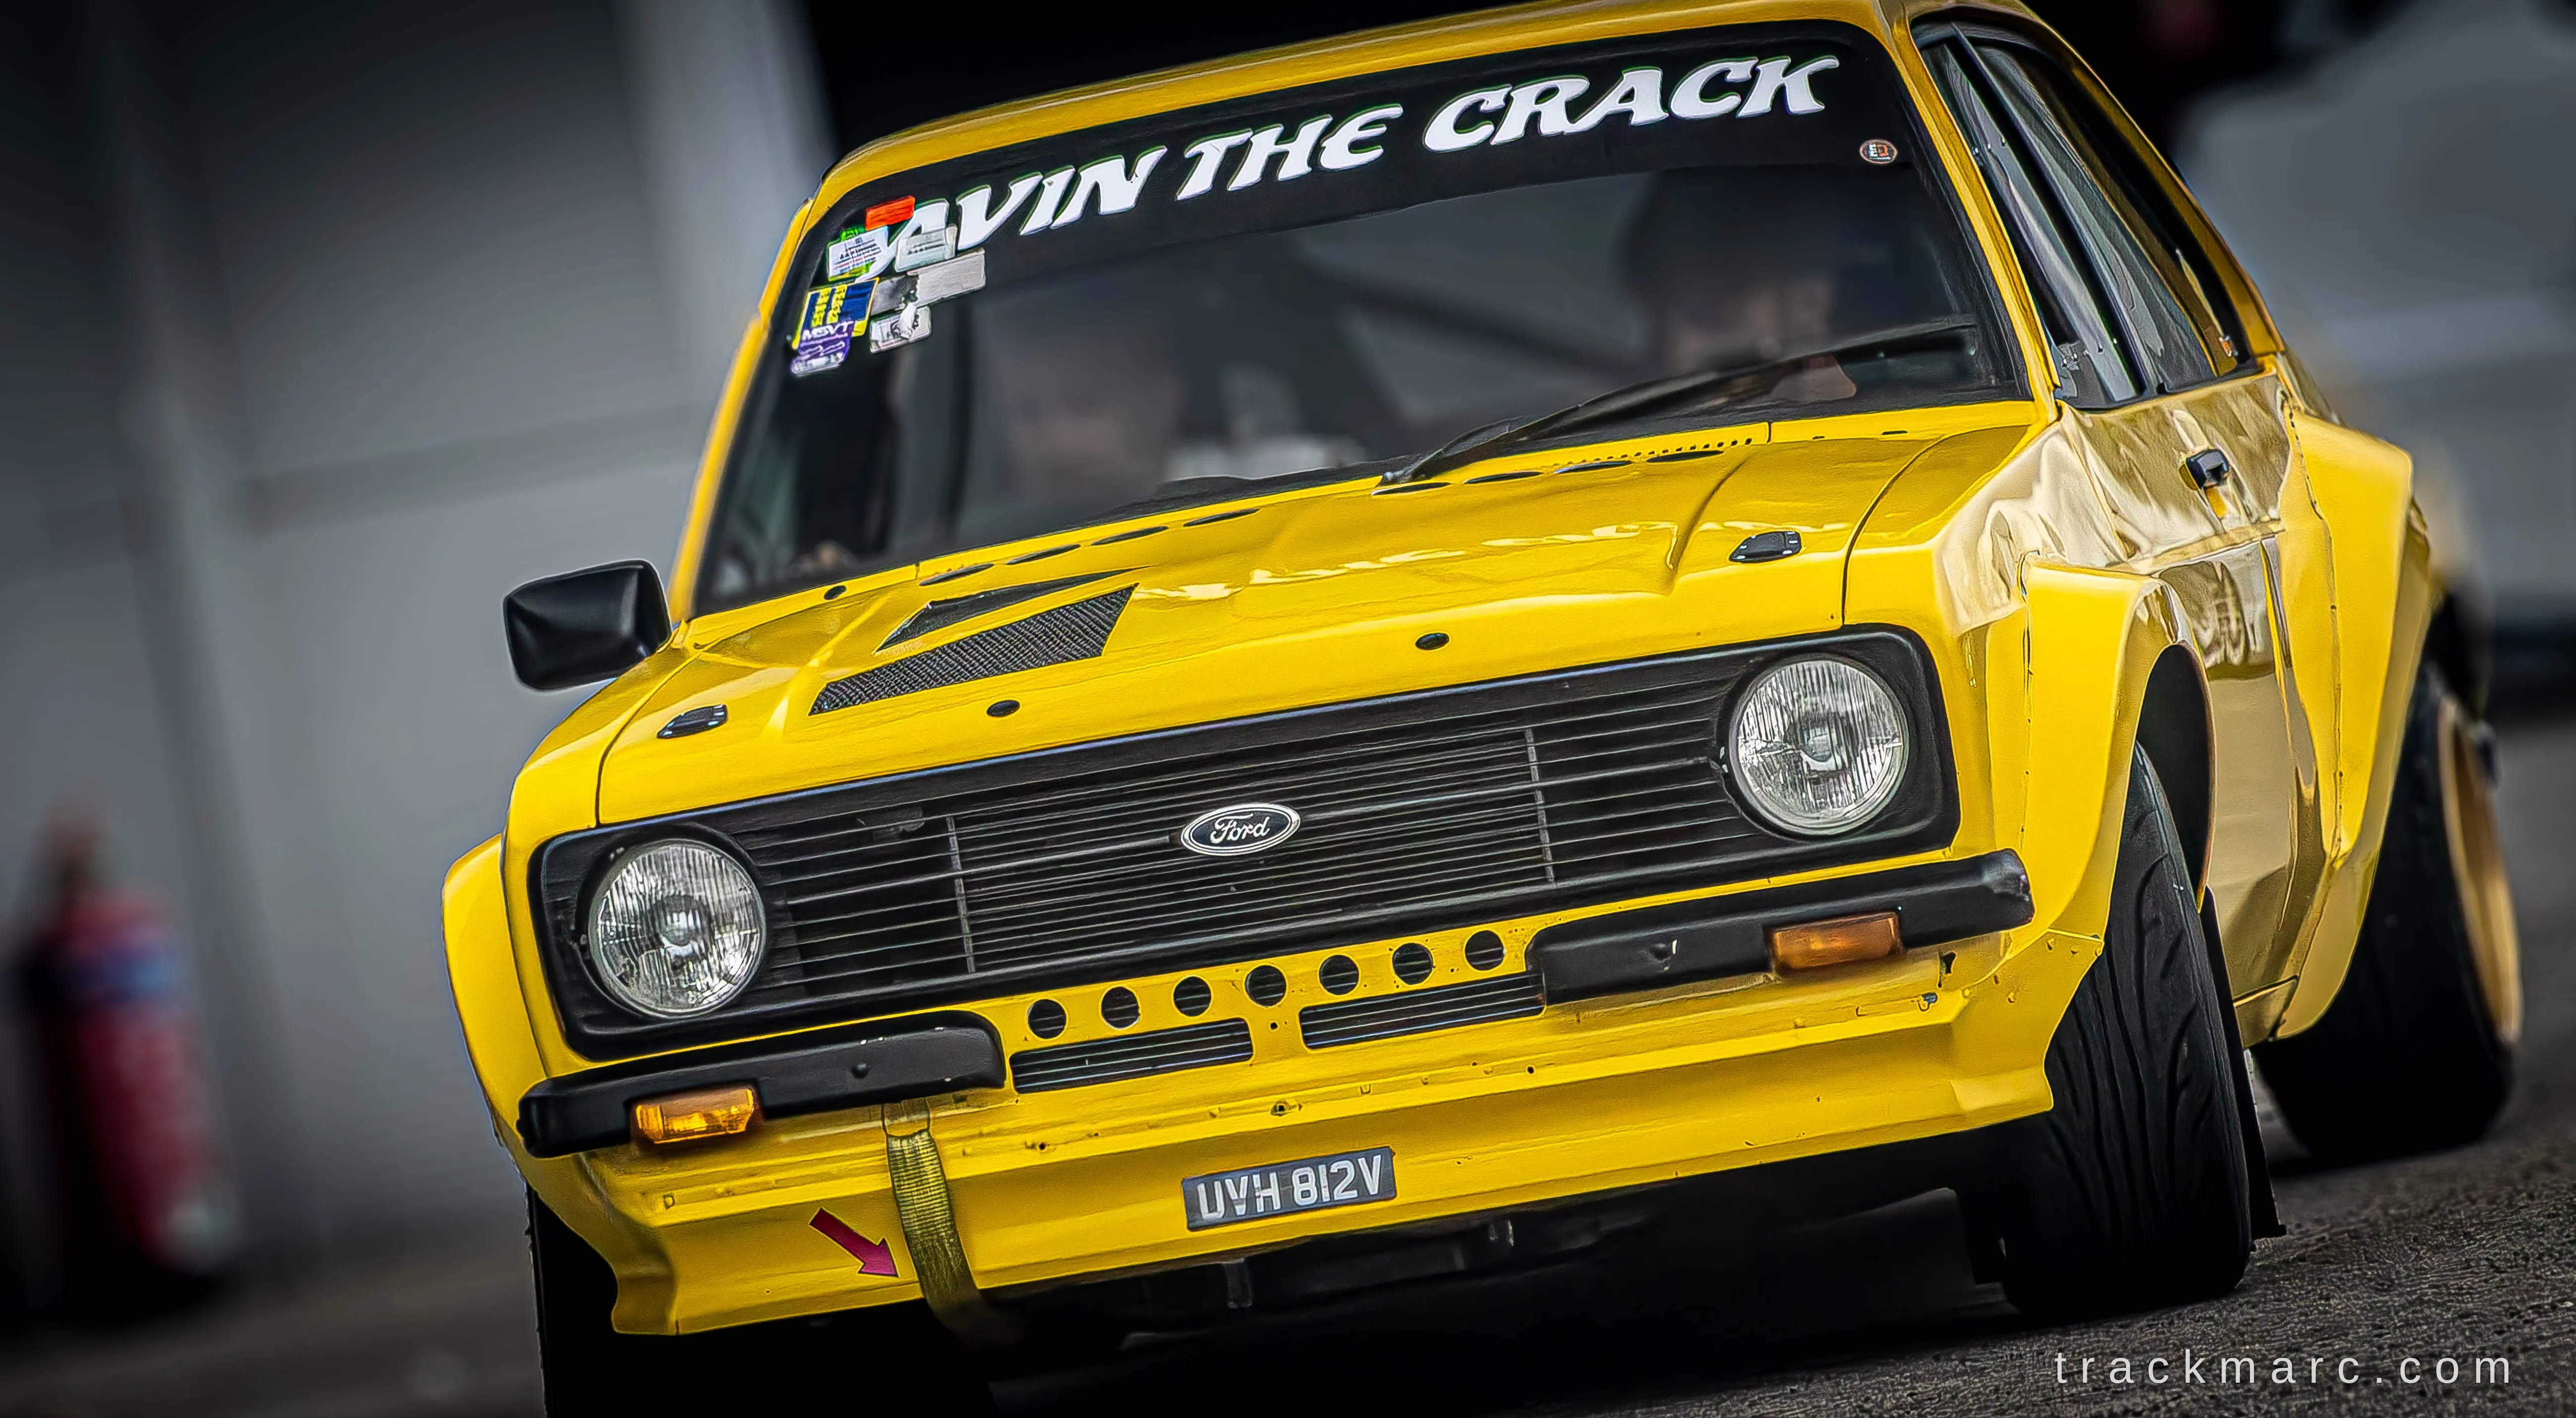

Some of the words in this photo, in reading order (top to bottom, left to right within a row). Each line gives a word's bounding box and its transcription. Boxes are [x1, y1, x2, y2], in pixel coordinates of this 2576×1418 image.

[1176, 104, 1404, 201] THE
[1424, 56, 1839, 151] CRACK
[1210, 813, 1270, 844] Ford
[1197, 1175, 1282, 1220] UVH
[1291, 1154, 1382, 1206] 812V
